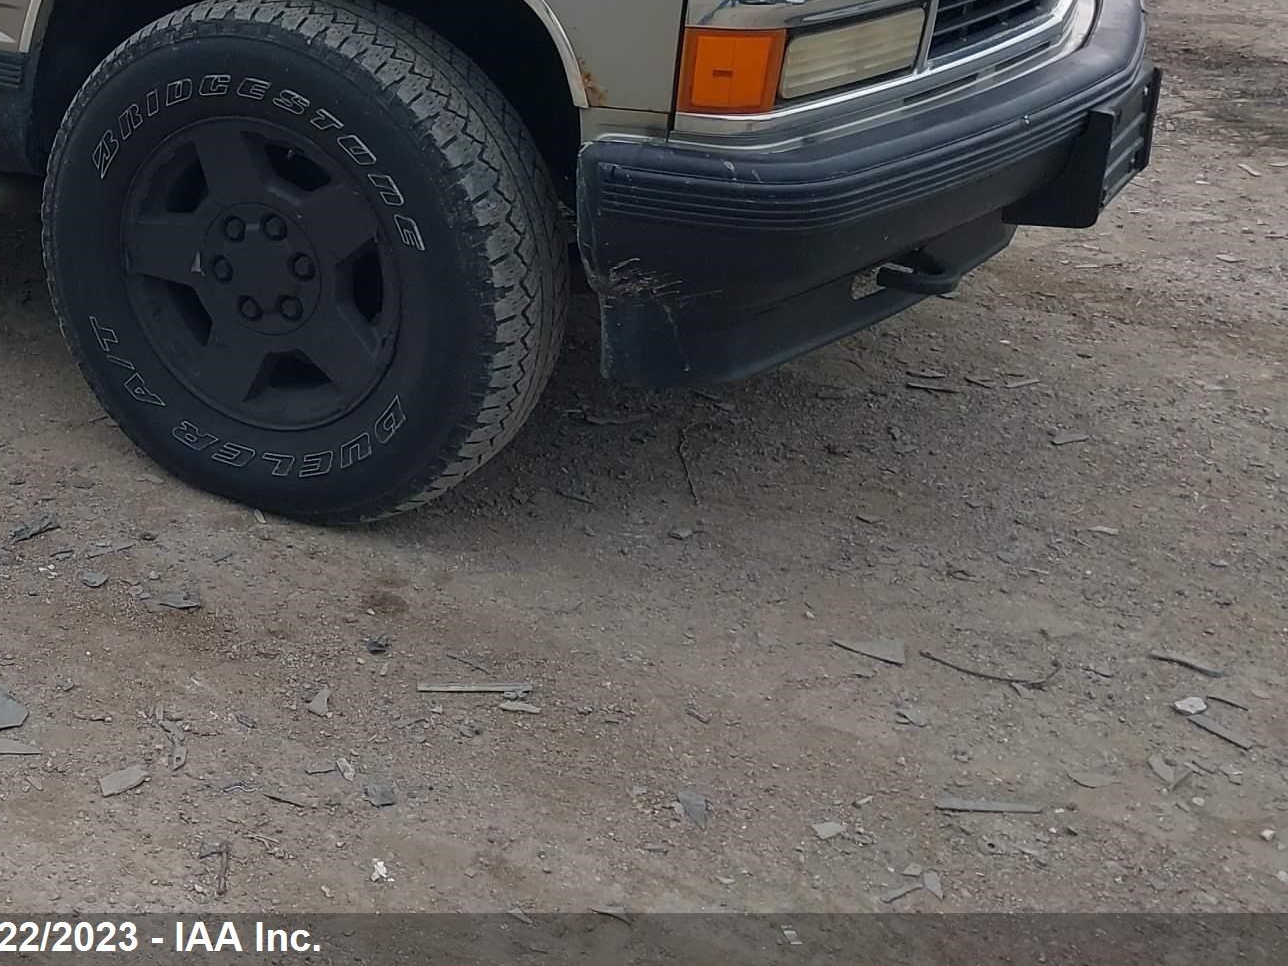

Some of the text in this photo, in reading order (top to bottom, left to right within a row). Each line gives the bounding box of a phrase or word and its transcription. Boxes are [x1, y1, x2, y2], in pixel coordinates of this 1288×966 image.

[91, 73, 426, 252] BRIDGESTONE
[89, 315, 166, 408] A/T
[171, 394, 409, 478] DUELER
